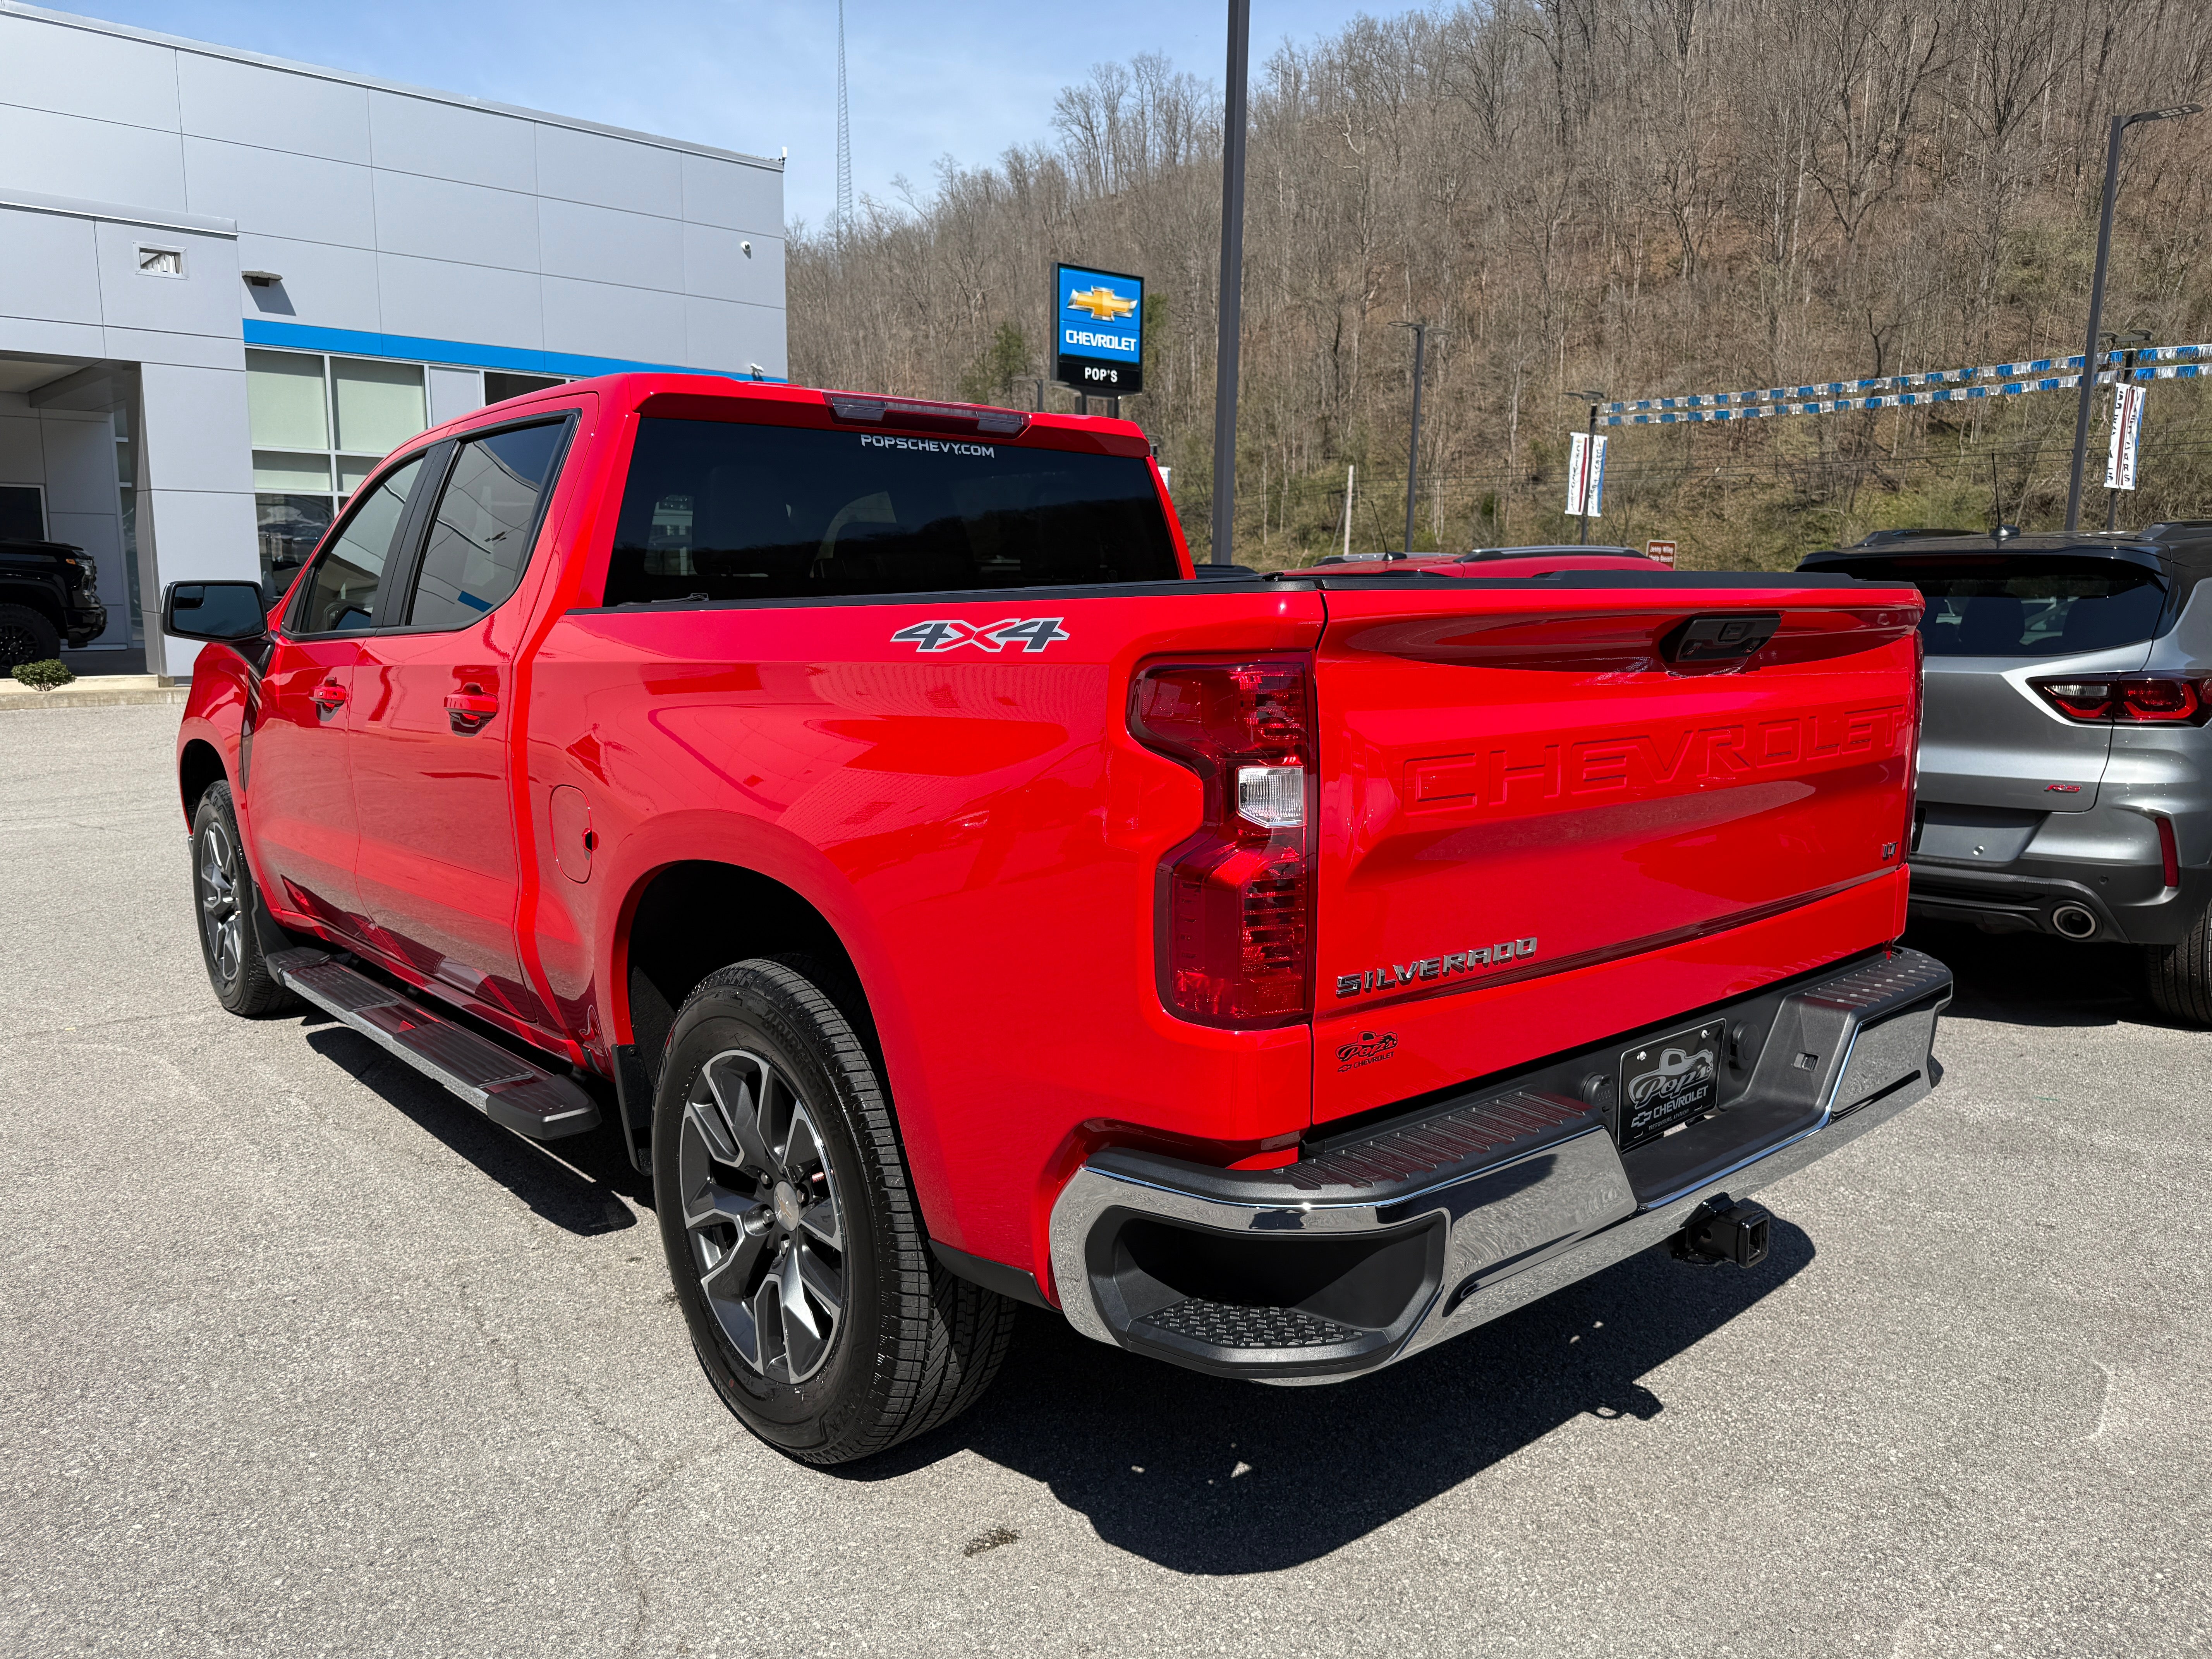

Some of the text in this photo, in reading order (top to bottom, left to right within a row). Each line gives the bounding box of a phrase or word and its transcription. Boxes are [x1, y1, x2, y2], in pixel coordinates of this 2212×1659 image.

[1065, 329, 1137, 351] CHEVROLET
[1085, 366, 1118, 383] POP'S
[860, 434, 995, 459] POPSCHEVY.COM
[1402, 704, 1905, 816] CHEVROLET
[1336, 936, 1537, 994] SILVERADO
[1337, 1039, 1397, 1062] Pop's
[1353, 1051, 1395, 1069] CHEVROLET
[1635, 1064, 1710, 1102] Pop's
[1653, 1085, 1709, 1119] CHEVROLET
